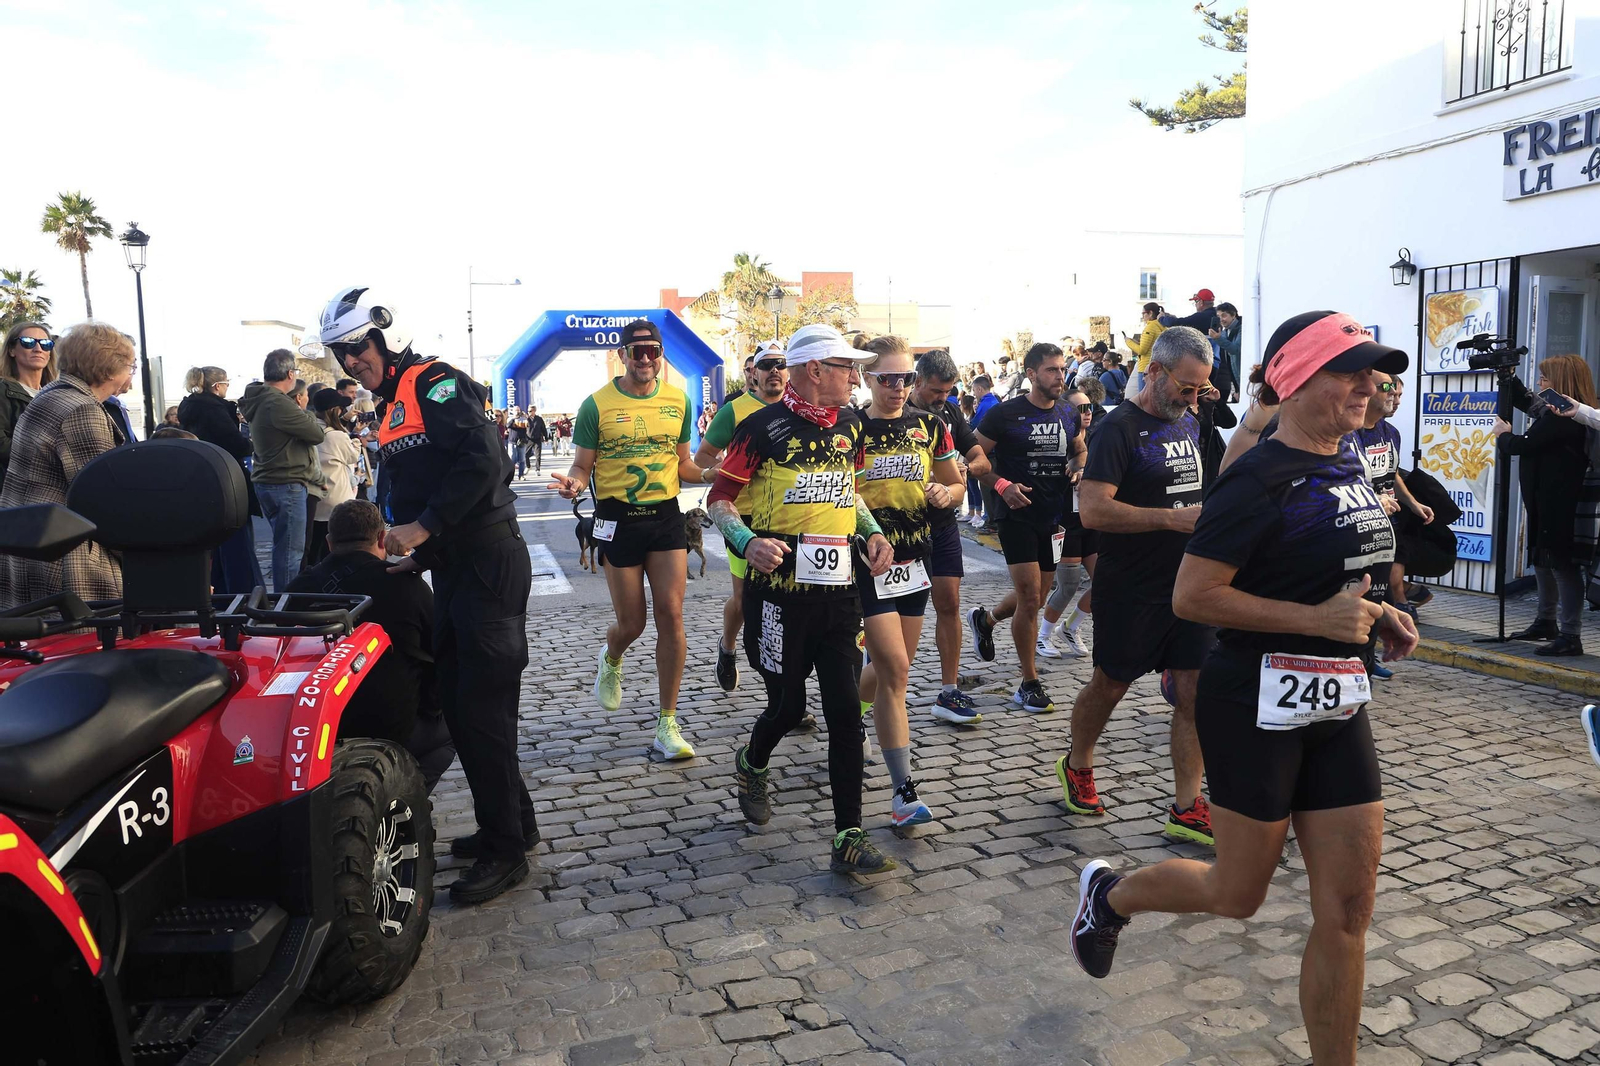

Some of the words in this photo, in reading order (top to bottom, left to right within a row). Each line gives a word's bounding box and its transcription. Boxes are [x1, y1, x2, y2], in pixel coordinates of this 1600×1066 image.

[1520, 163, 1554, 195] LA
[1462, 312, 1493, 337] Fish
[595, 331, 620, 345] 0.0
[1427, 394, 1458, 412] Take
[1458, 394, 1497, 415] Away
[1031, 423, 1058, 435] XVI
[1424, 418, 1451, 426] PARA
[1454, 418, 1494, 426] LLEVAR
[1162, 440, 1193, 459] XVI
[873, 453, 920, 469] SIERRA
[1165, 459, 1187, 467] CARRERA
[1173, 464, 1197, 473] ESTRECHO
[1371, 453, 1386, 469] 419
[794, 471, 853, 489] SIERRA
[866, 464, 925, 481] BERMEJA
[783, 486, 855, 504] BERMEJA
[1328, 484, 1377, 513] XVI
[1335, 510, 1374, 528] CARRERA
[1356, 518, 1391, 533] ESTRECHO
[1457, 536, 1487, 556] Fish
[814, 548, 839, 570] 99
[771, 622, 784, 675] SIERRA
[299, 643, 356, 708] PROTECCION
[1276, 674, 1342, 711] 249
[290, 726, 311, 791] CIVIL
[118, 786, 170, 845] R-3
